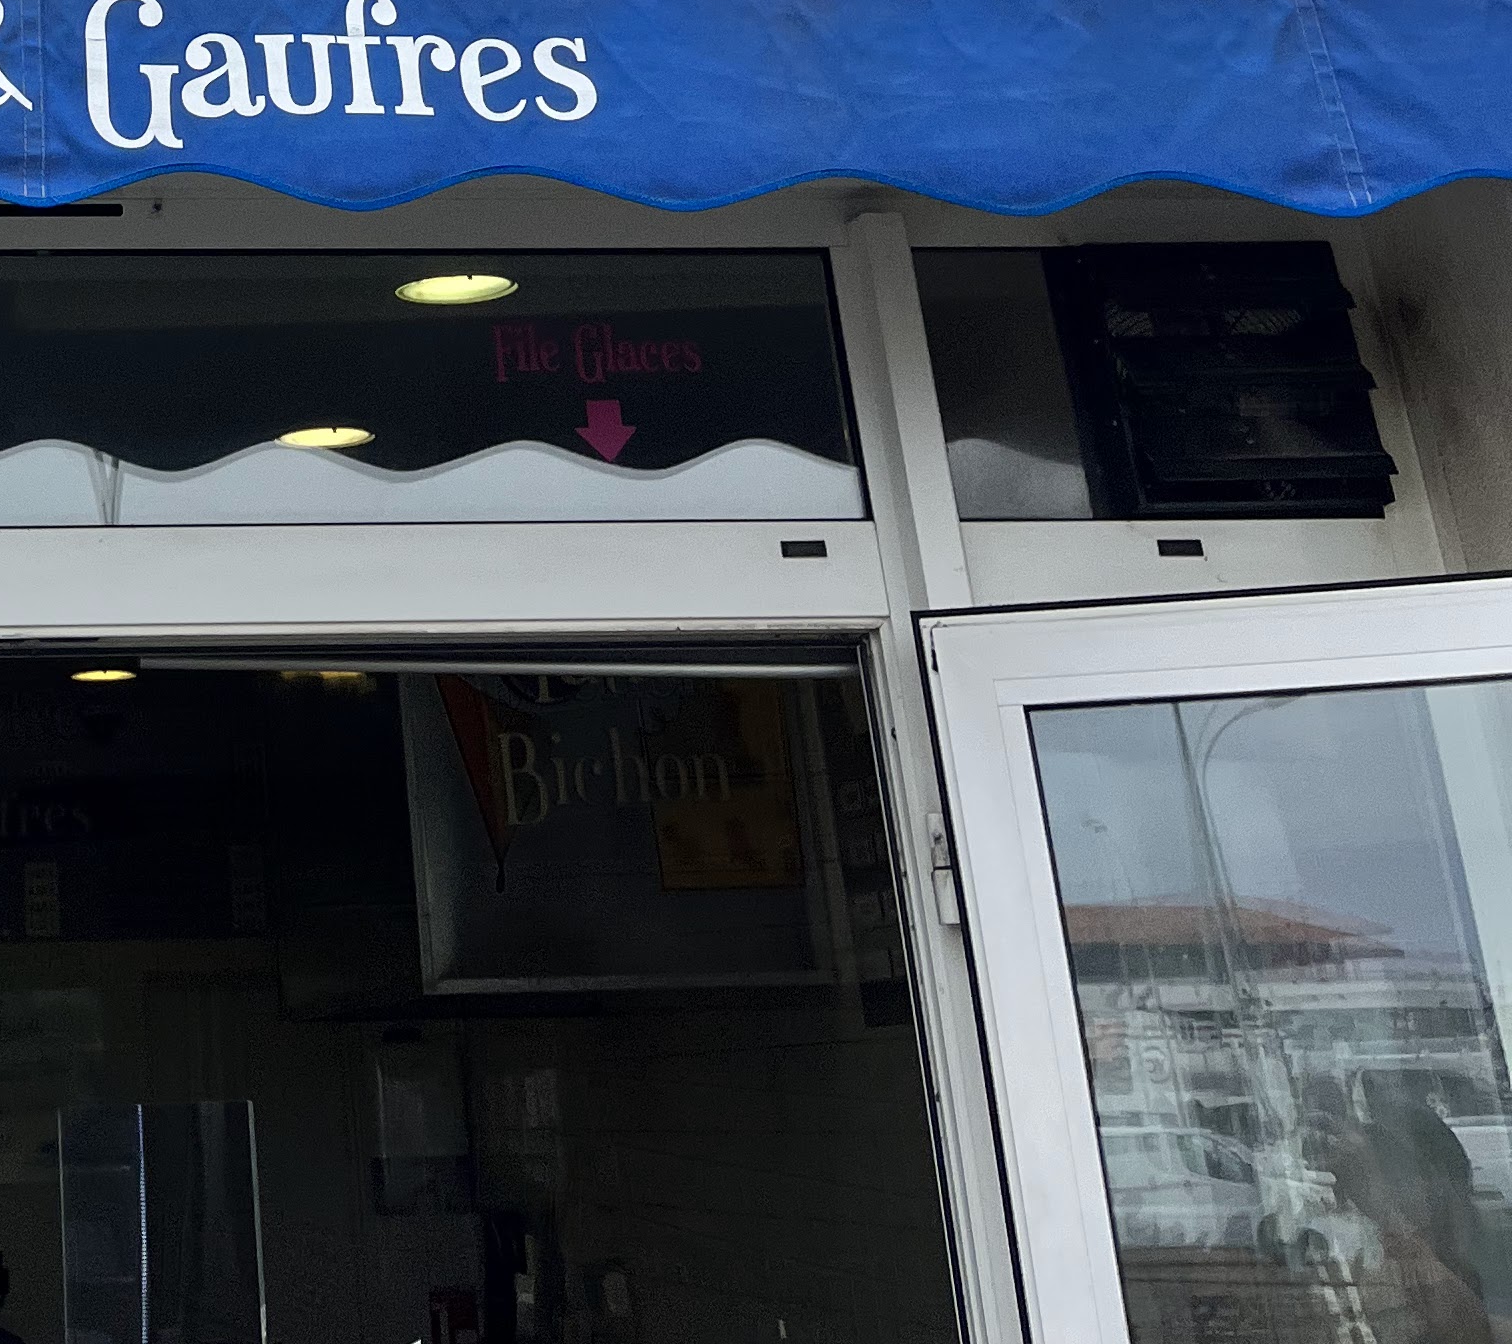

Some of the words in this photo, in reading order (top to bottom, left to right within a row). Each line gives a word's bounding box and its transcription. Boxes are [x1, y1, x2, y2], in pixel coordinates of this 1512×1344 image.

[492, 322, 560, 383] File
[574, 322, 703, 385] Glaces
[497, 727, 731, 826] Bichon
